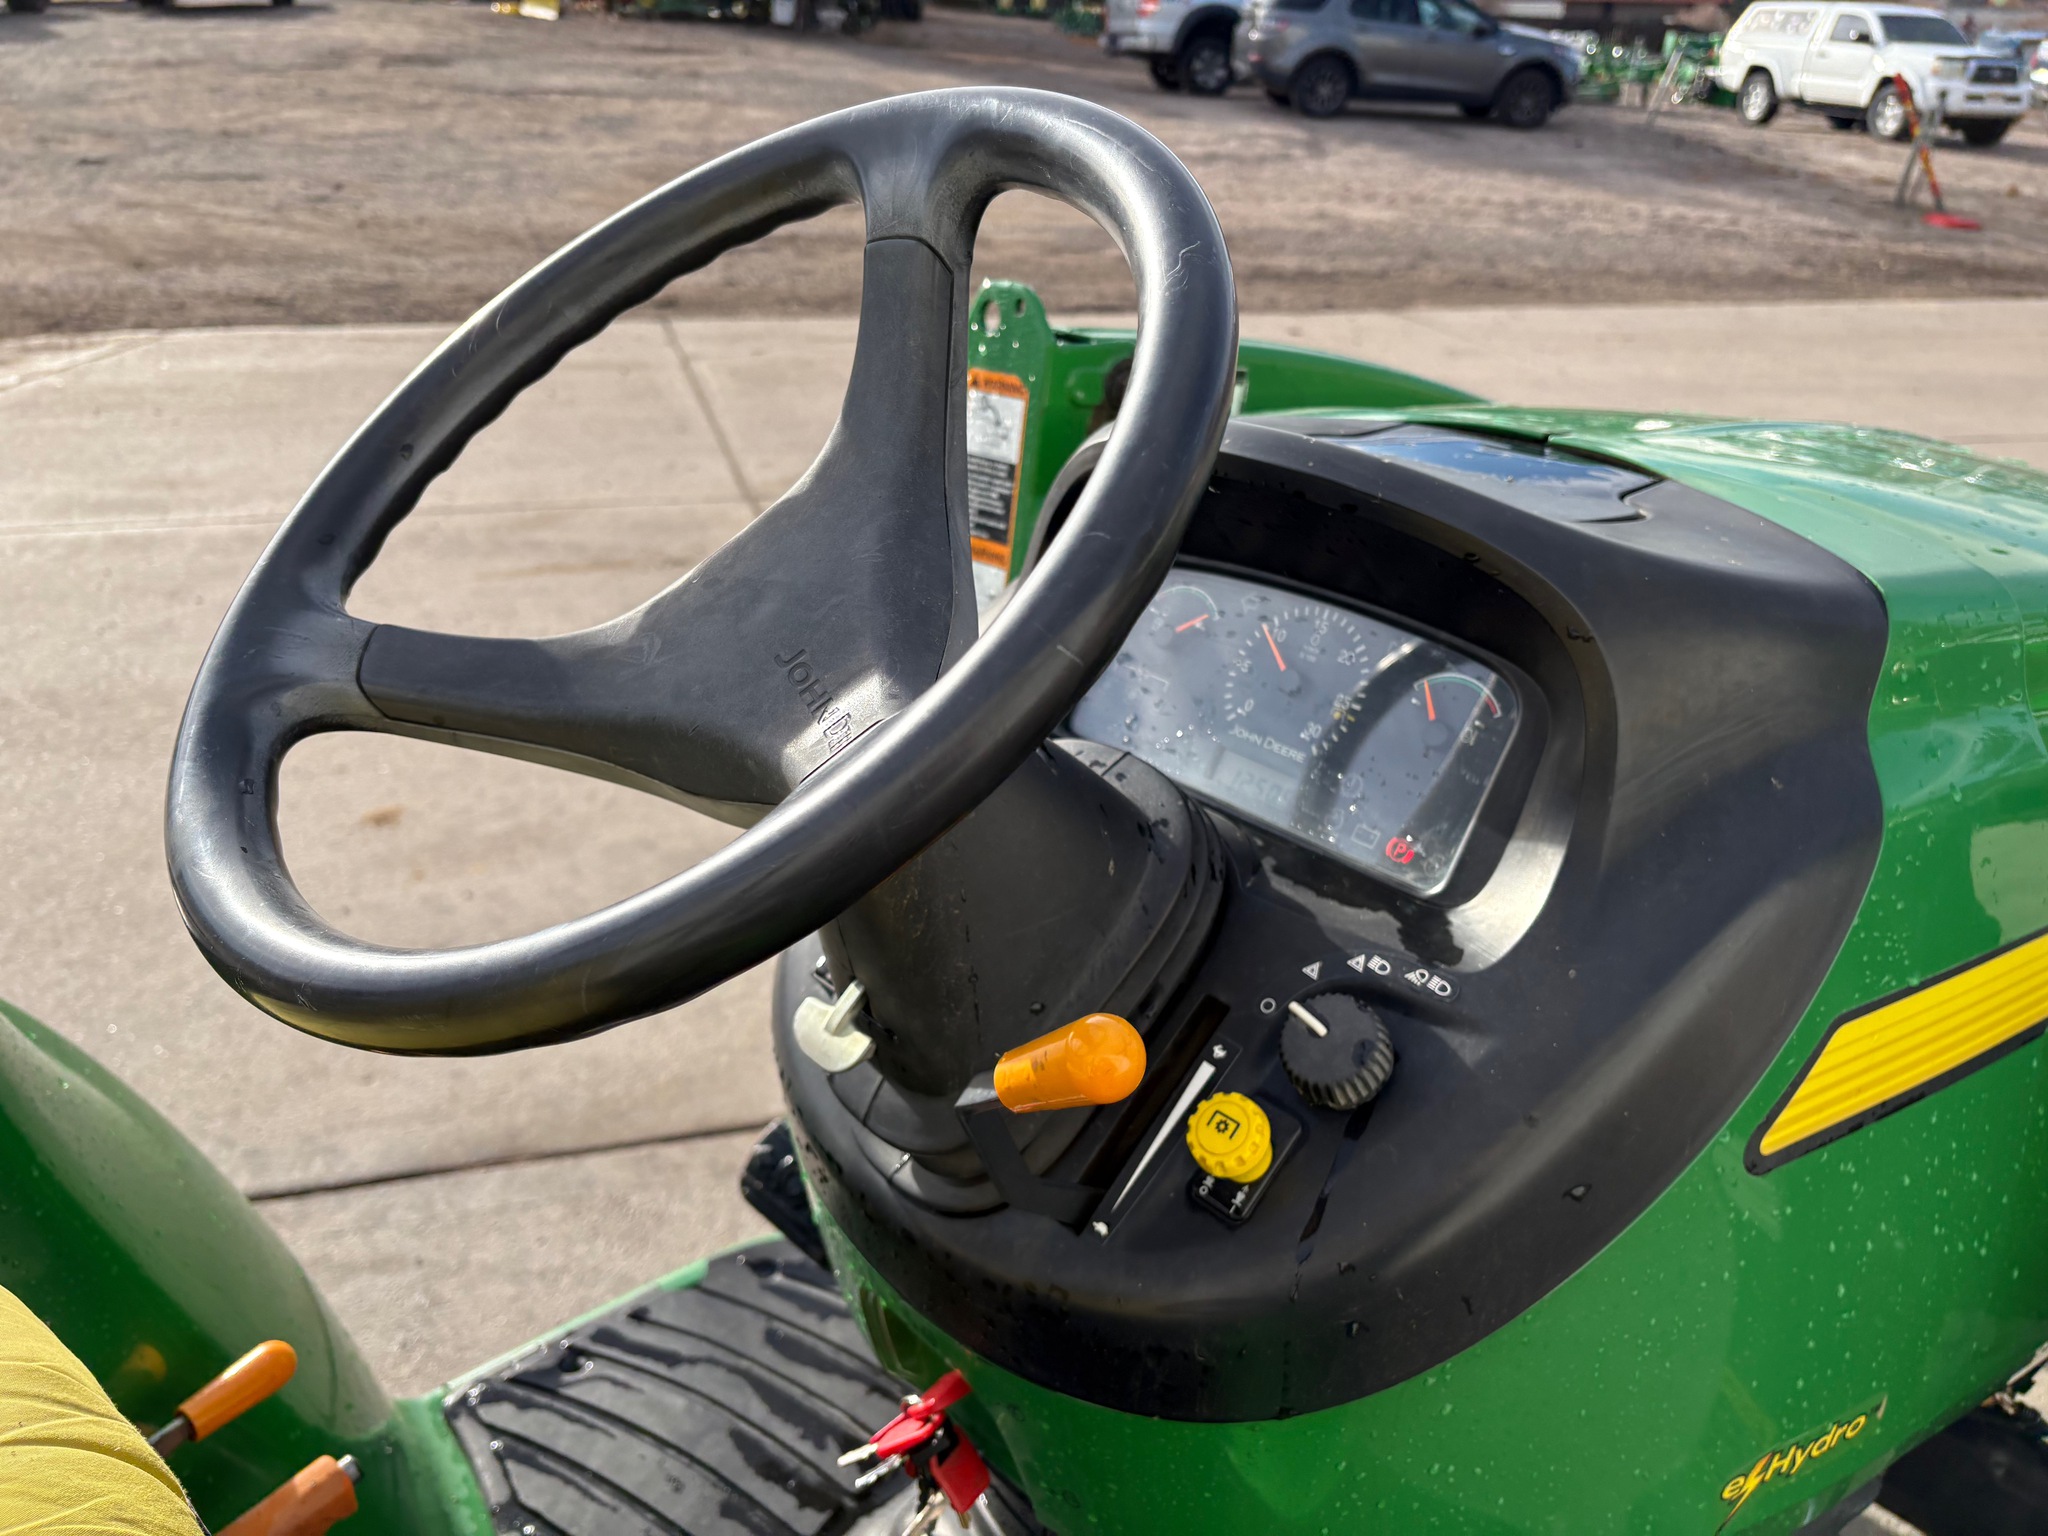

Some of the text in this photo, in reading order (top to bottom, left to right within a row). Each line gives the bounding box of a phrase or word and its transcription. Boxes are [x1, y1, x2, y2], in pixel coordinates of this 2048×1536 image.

[774, 649, 840, 725] JOHN
[1228, 724, 1307, 764] JOHN DEERE
